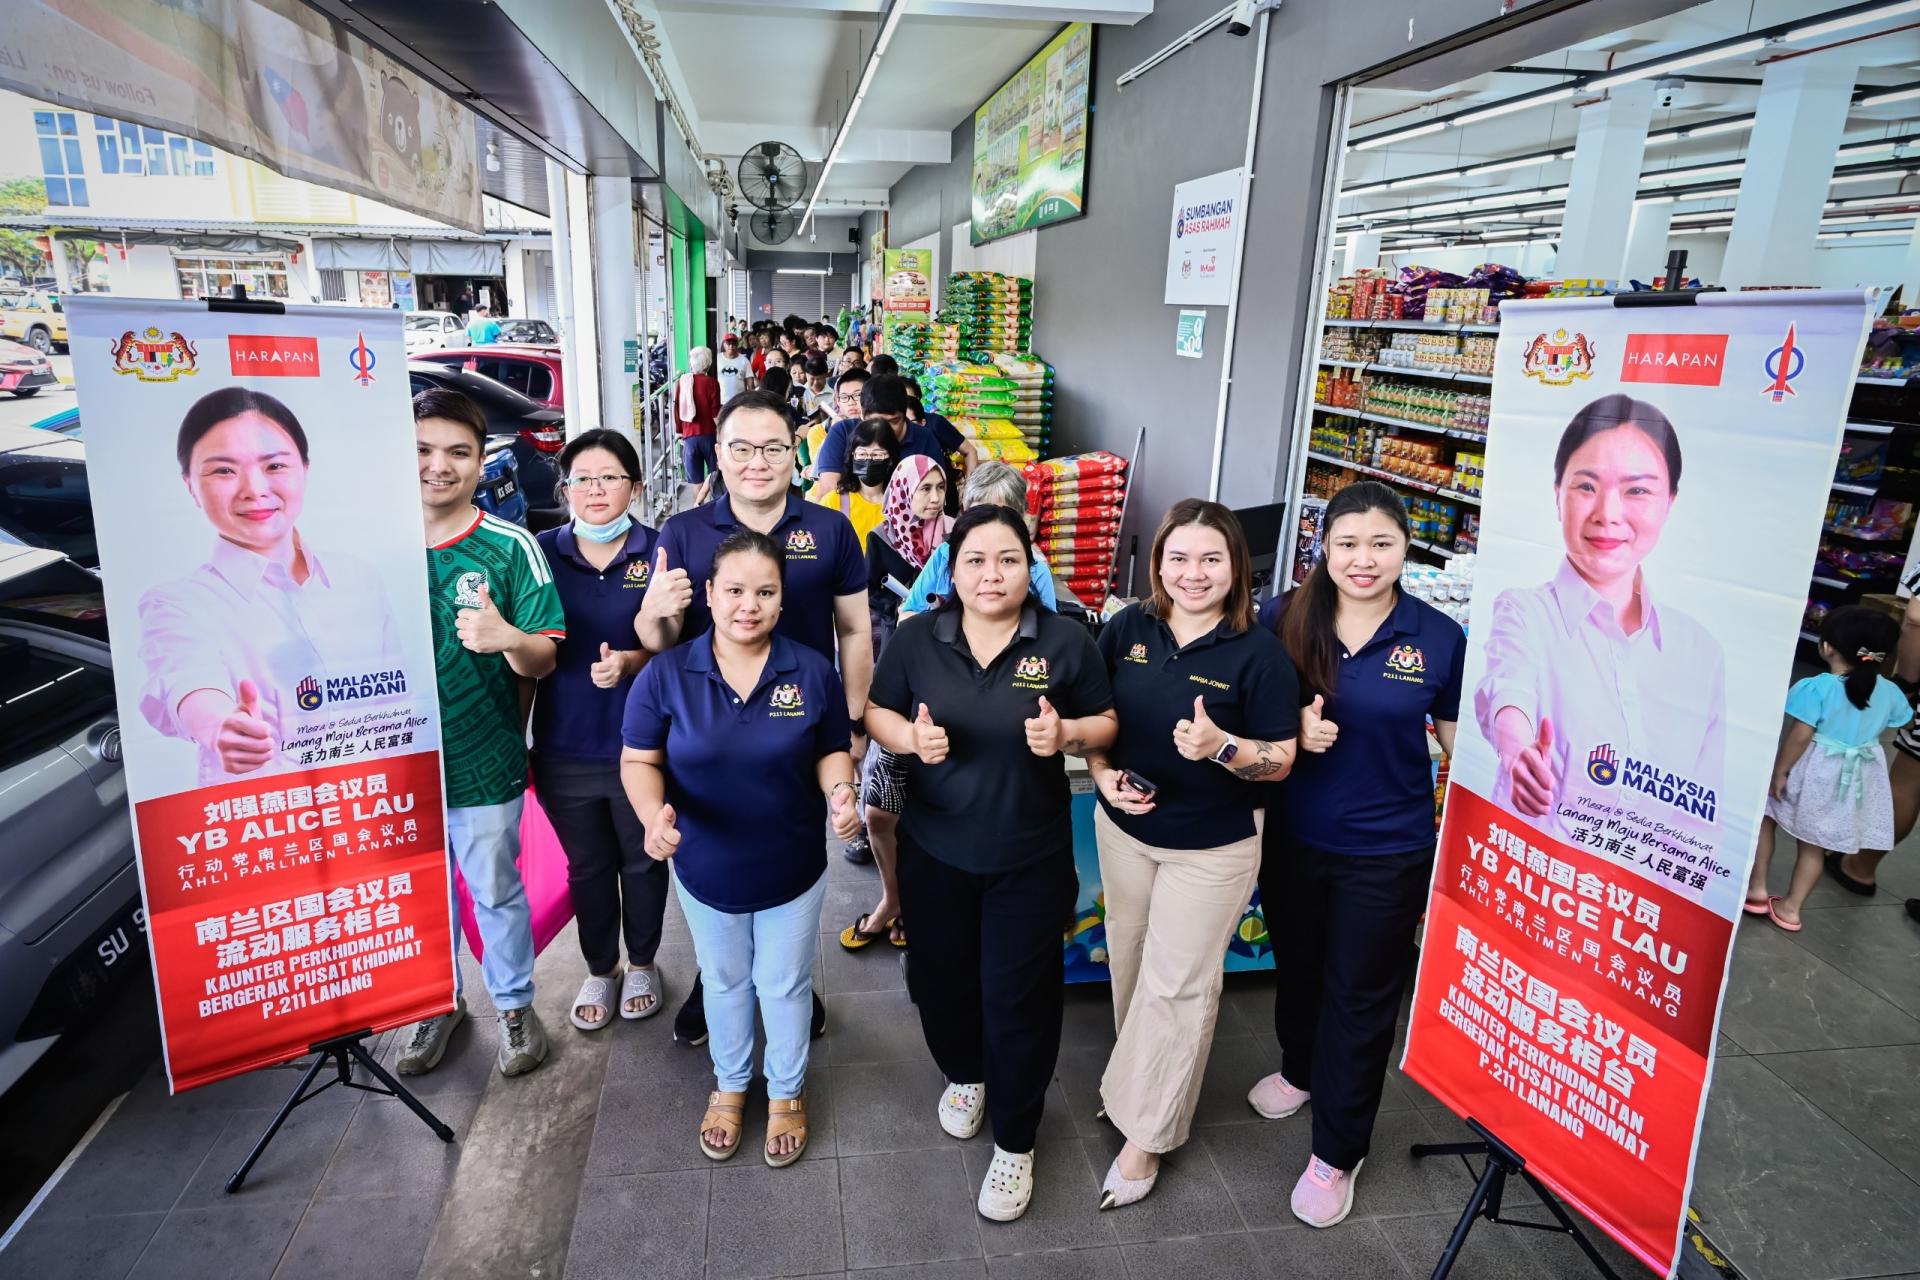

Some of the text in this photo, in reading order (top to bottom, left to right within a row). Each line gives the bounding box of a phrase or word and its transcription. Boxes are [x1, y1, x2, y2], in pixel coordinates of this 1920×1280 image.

[1184, 216, 1231, 236] ASAS RAHMAH
[1186, 199, 1233, 220] SUMBANGAN
[236, 350, 314, 363] HARAPAN
[1628, 352, 1718, 368] HARAPAN
[326, 670, 404, 689] MALAYSIA
[328, 680, 406, 702] MADANI
[1400, 674, 1424, 684] LANANG
[280, 716, 428, 752] Lanang Maju Bersama Alice
[300, 732, 413, 765] 活力南兰 人民富强
[204, 773, 388, 826] 刘强燕国会议员
[1622, 770, 1716, 822] MADANI
[1625, 757, 1716, 805] MALAYSIA
[176, 794, 414, 855] YB ALICE LAU
[178, 818, 418, 880] 行动党南兰区国会议员
[1556, 802, 1732, 878] Lanang Maju Bersama Alice
[1626, 811, 1653, 828] Sedia
[1654, 822, 1714, 853] Berkhidmat
[181, 833, 418, 890] AHLI PARLIMEN LANANG
[1487, 822, 1661, 932] 刘强燕国会议员
[1571, 827, 1708, 892] 活力南兰 人民富强
[194, 872, 412, 945] 南兰区国会议员
[1460, 863, 1682, 1006] 行动党南兰区国会议员
[1466, 834, 1688, 975] YB ALICE LAU
[97, 927, 130, 966] SU
[205, 925, 415, 996] KAUNTER PERKHIDMATAN
[216, 902, 401, 970] 流动服务柜台
[1459, 882, 1678, 1018] AHLI PARLIMEN LANANG
[198, 940, 423, 1018] BERGERAK PUSAT KHIDMAT
[262, 972, 372, 1020] P.211 LANANG
[1455, 924, 1658, 1079] 南兰区国会议员
[1448, 984, 1645, 1136] KAUNTER PERKHIDMATAN
[1461, 962, 1636, 1099] 流动服务柜台
[1439, 998, 1650, 1162] BERGERAK PUSAT KHIDMAT
[1479, 1050, 1585, 1140] P.211 LANANG
